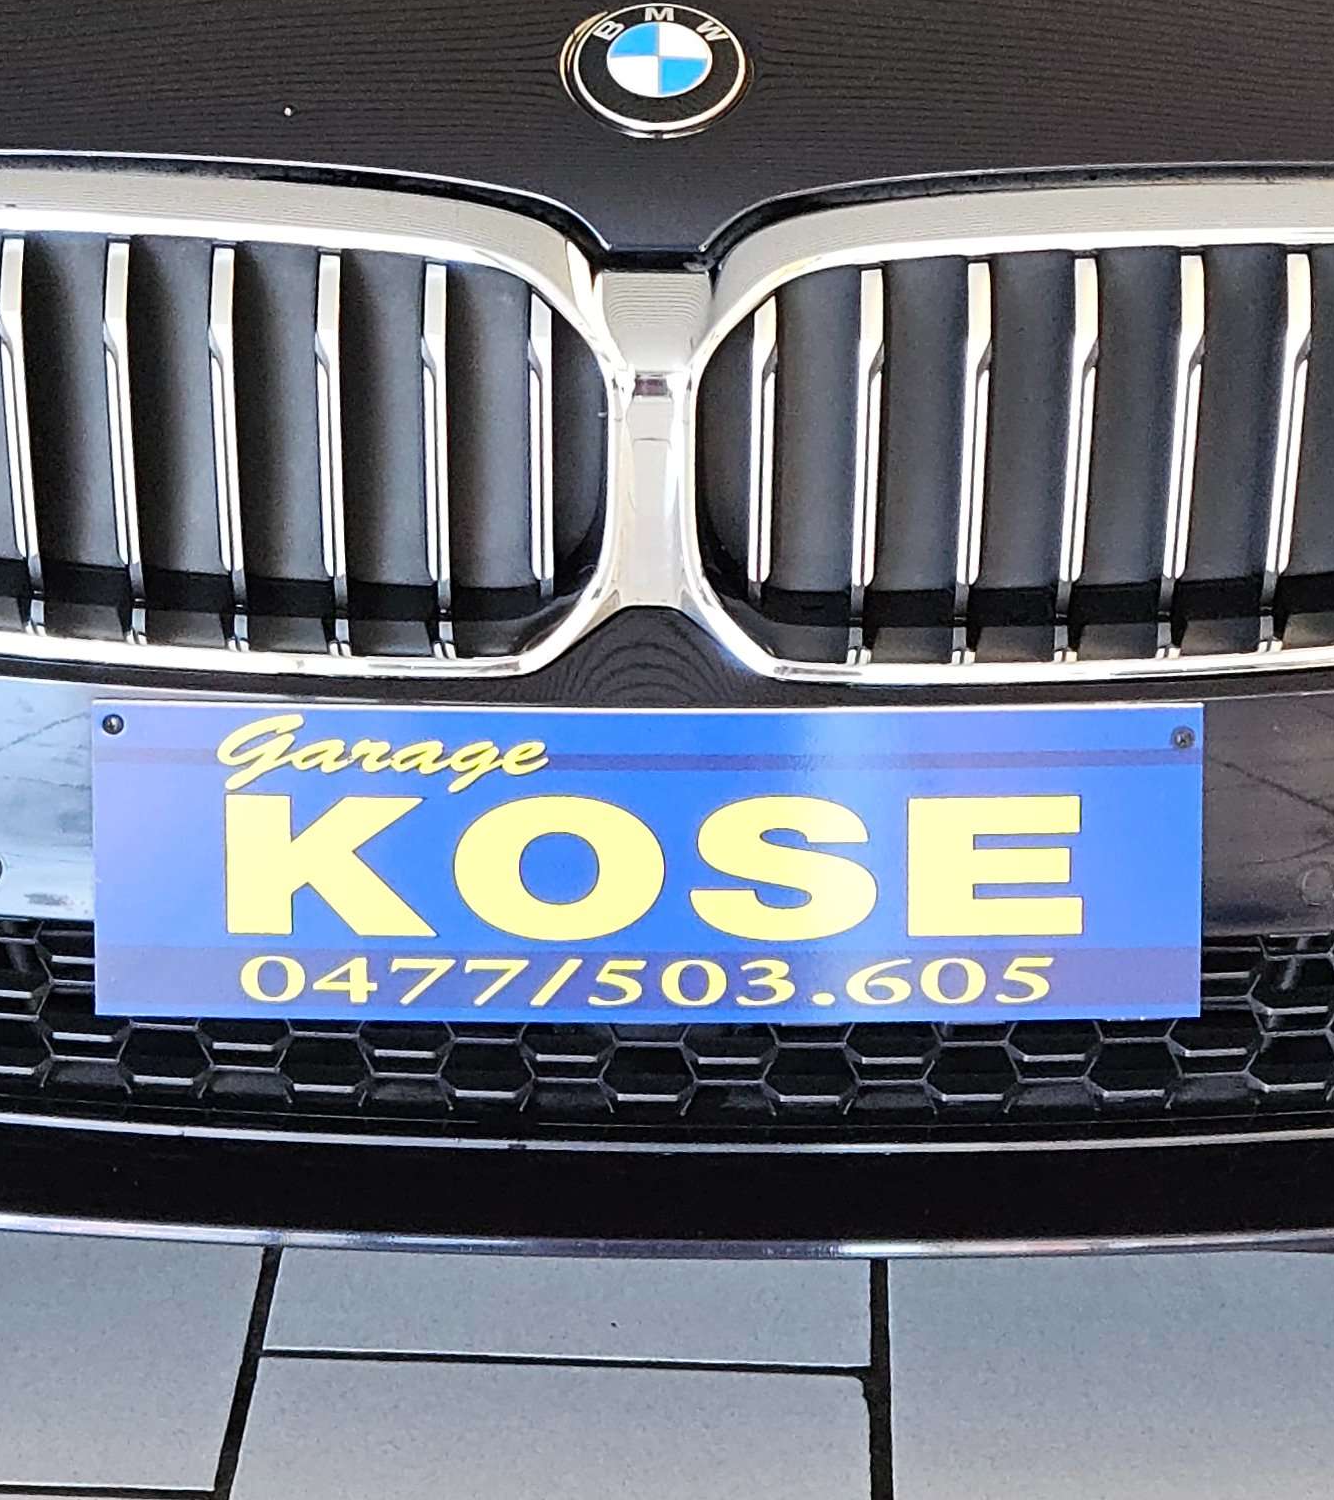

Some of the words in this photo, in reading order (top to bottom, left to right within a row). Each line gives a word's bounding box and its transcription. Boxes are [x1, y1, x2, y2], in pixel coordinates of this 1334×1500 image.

[593, 7, 730, 42] BMW
[217, 713, 550, 793] Garage
[223, 794, 1084, 941] KOSE
[238, 953, 1055, 1008] 0477/503.605
